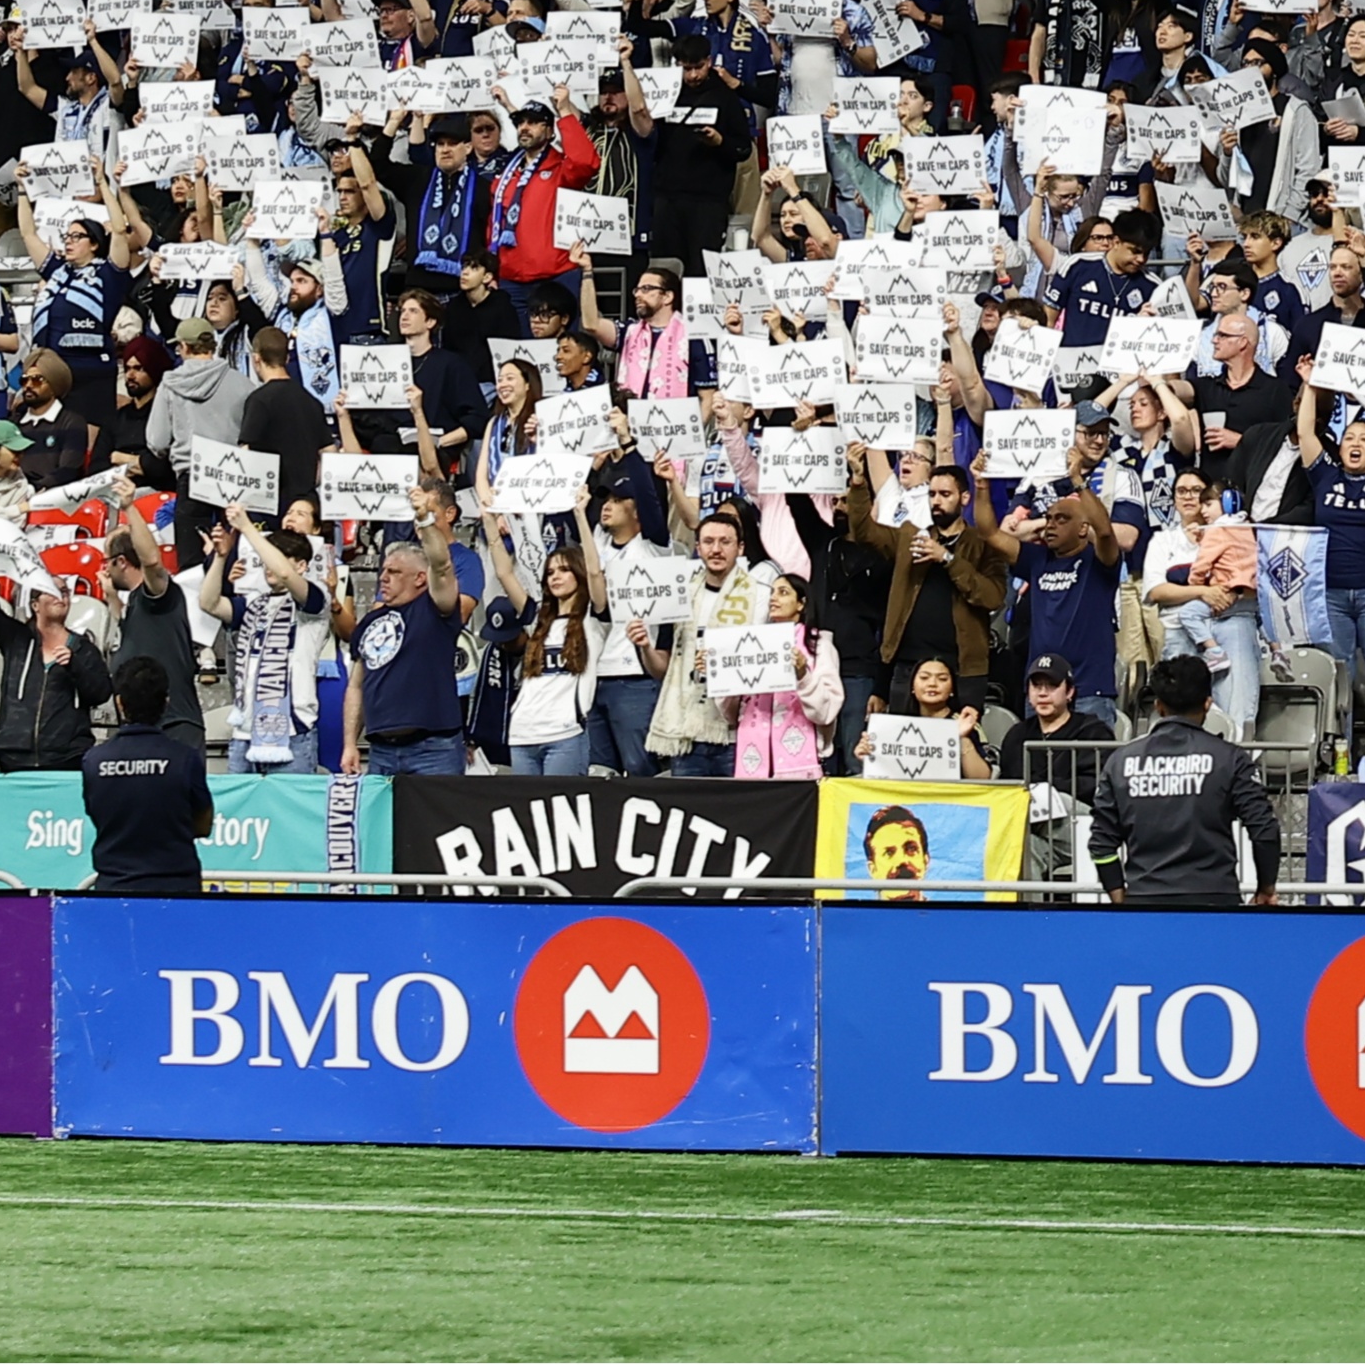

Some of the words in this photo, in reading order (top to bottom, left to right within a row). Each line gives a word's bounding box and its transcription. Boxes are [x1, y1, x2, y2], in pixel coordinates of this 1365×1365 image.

[1079, 296, 1127, 319] TELU
[71, 317, 95, 329] bclc
[1333, 352, 1355, 366] SAVE
[997, 438, 1019, 450] SAVE
[1020, 439, 1031, 448] THE
[1033, 437, 1056, 449] CAPS
[204, 466, 225, 480] SAVE
[238, 474, 261, 488] CAPS
[337, 482, 360, 493] SAVE
[375, 482, 399, 494] CAPS
[722, 655, 742, 667] SAVE
[743, 655, 754, 665] THE
[756, 652, 778, 665] CAPS
[881, 743, 904, 756] SAVE
[905, 746, 917, 756] THE
[919, 745, 943, 758] CAPS
[98, 758, 169, 777] SECURITY
[1124, 753, 1213, 778] BLACKBIRD
[1127, 774, 1206, 798] SECURITY
[25, 810, 84, 855] Sing
[435, 793, 597, 896] RAIN
[615, 796, 772, 899] CITY
[158, 969, 469, 1072] BMO
[928, 981, 1260, 1088] BMO
